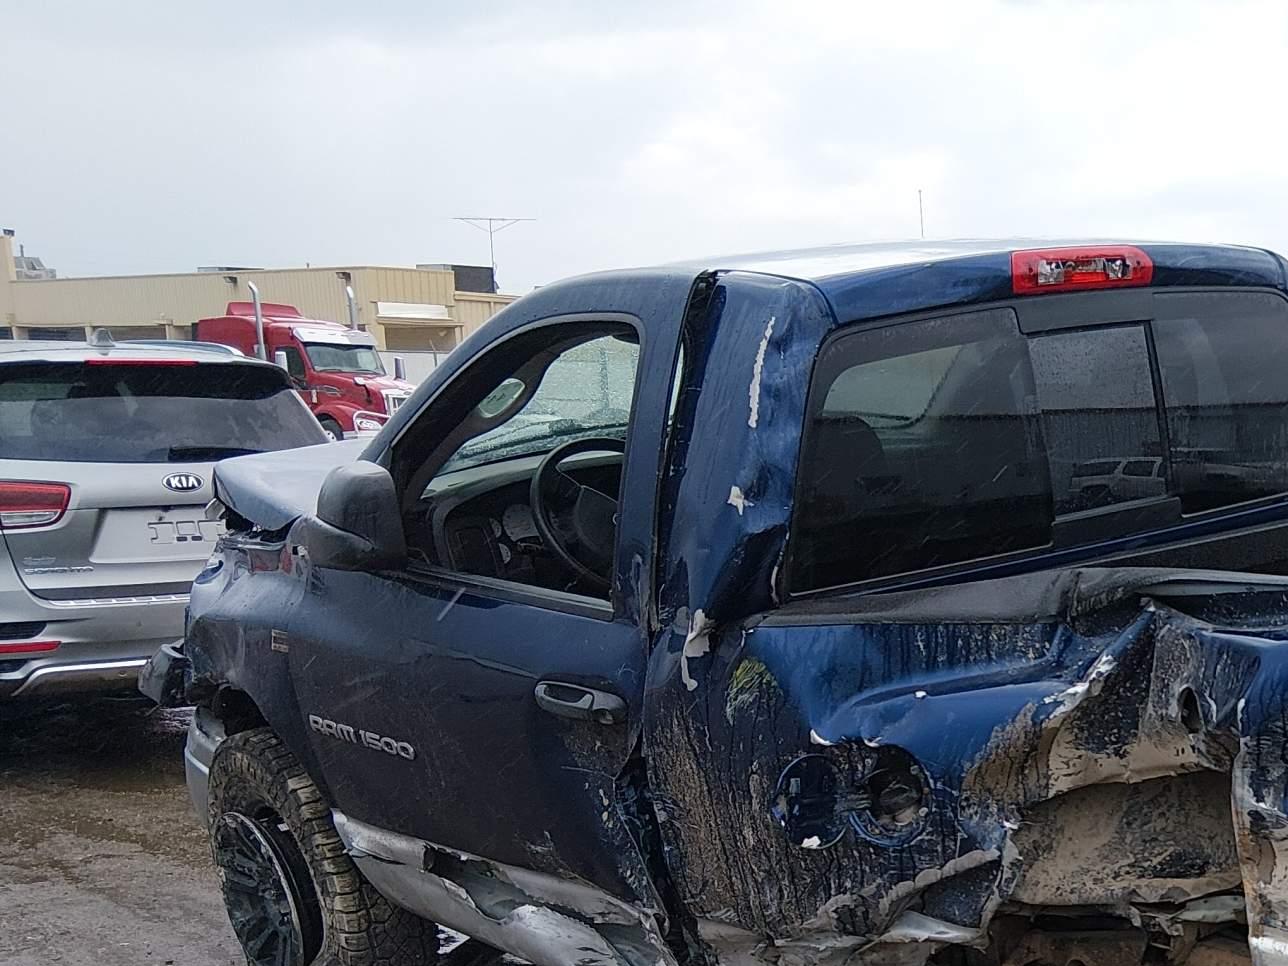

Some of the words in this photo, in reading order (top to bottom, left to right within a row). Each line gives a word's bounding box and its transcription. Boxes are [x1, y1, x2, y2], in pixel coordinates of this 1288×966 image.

[168, 475, 200, 489] KIA
[308, 713, 358, 744] RAM
[358, 729, 416, 761] 1500
